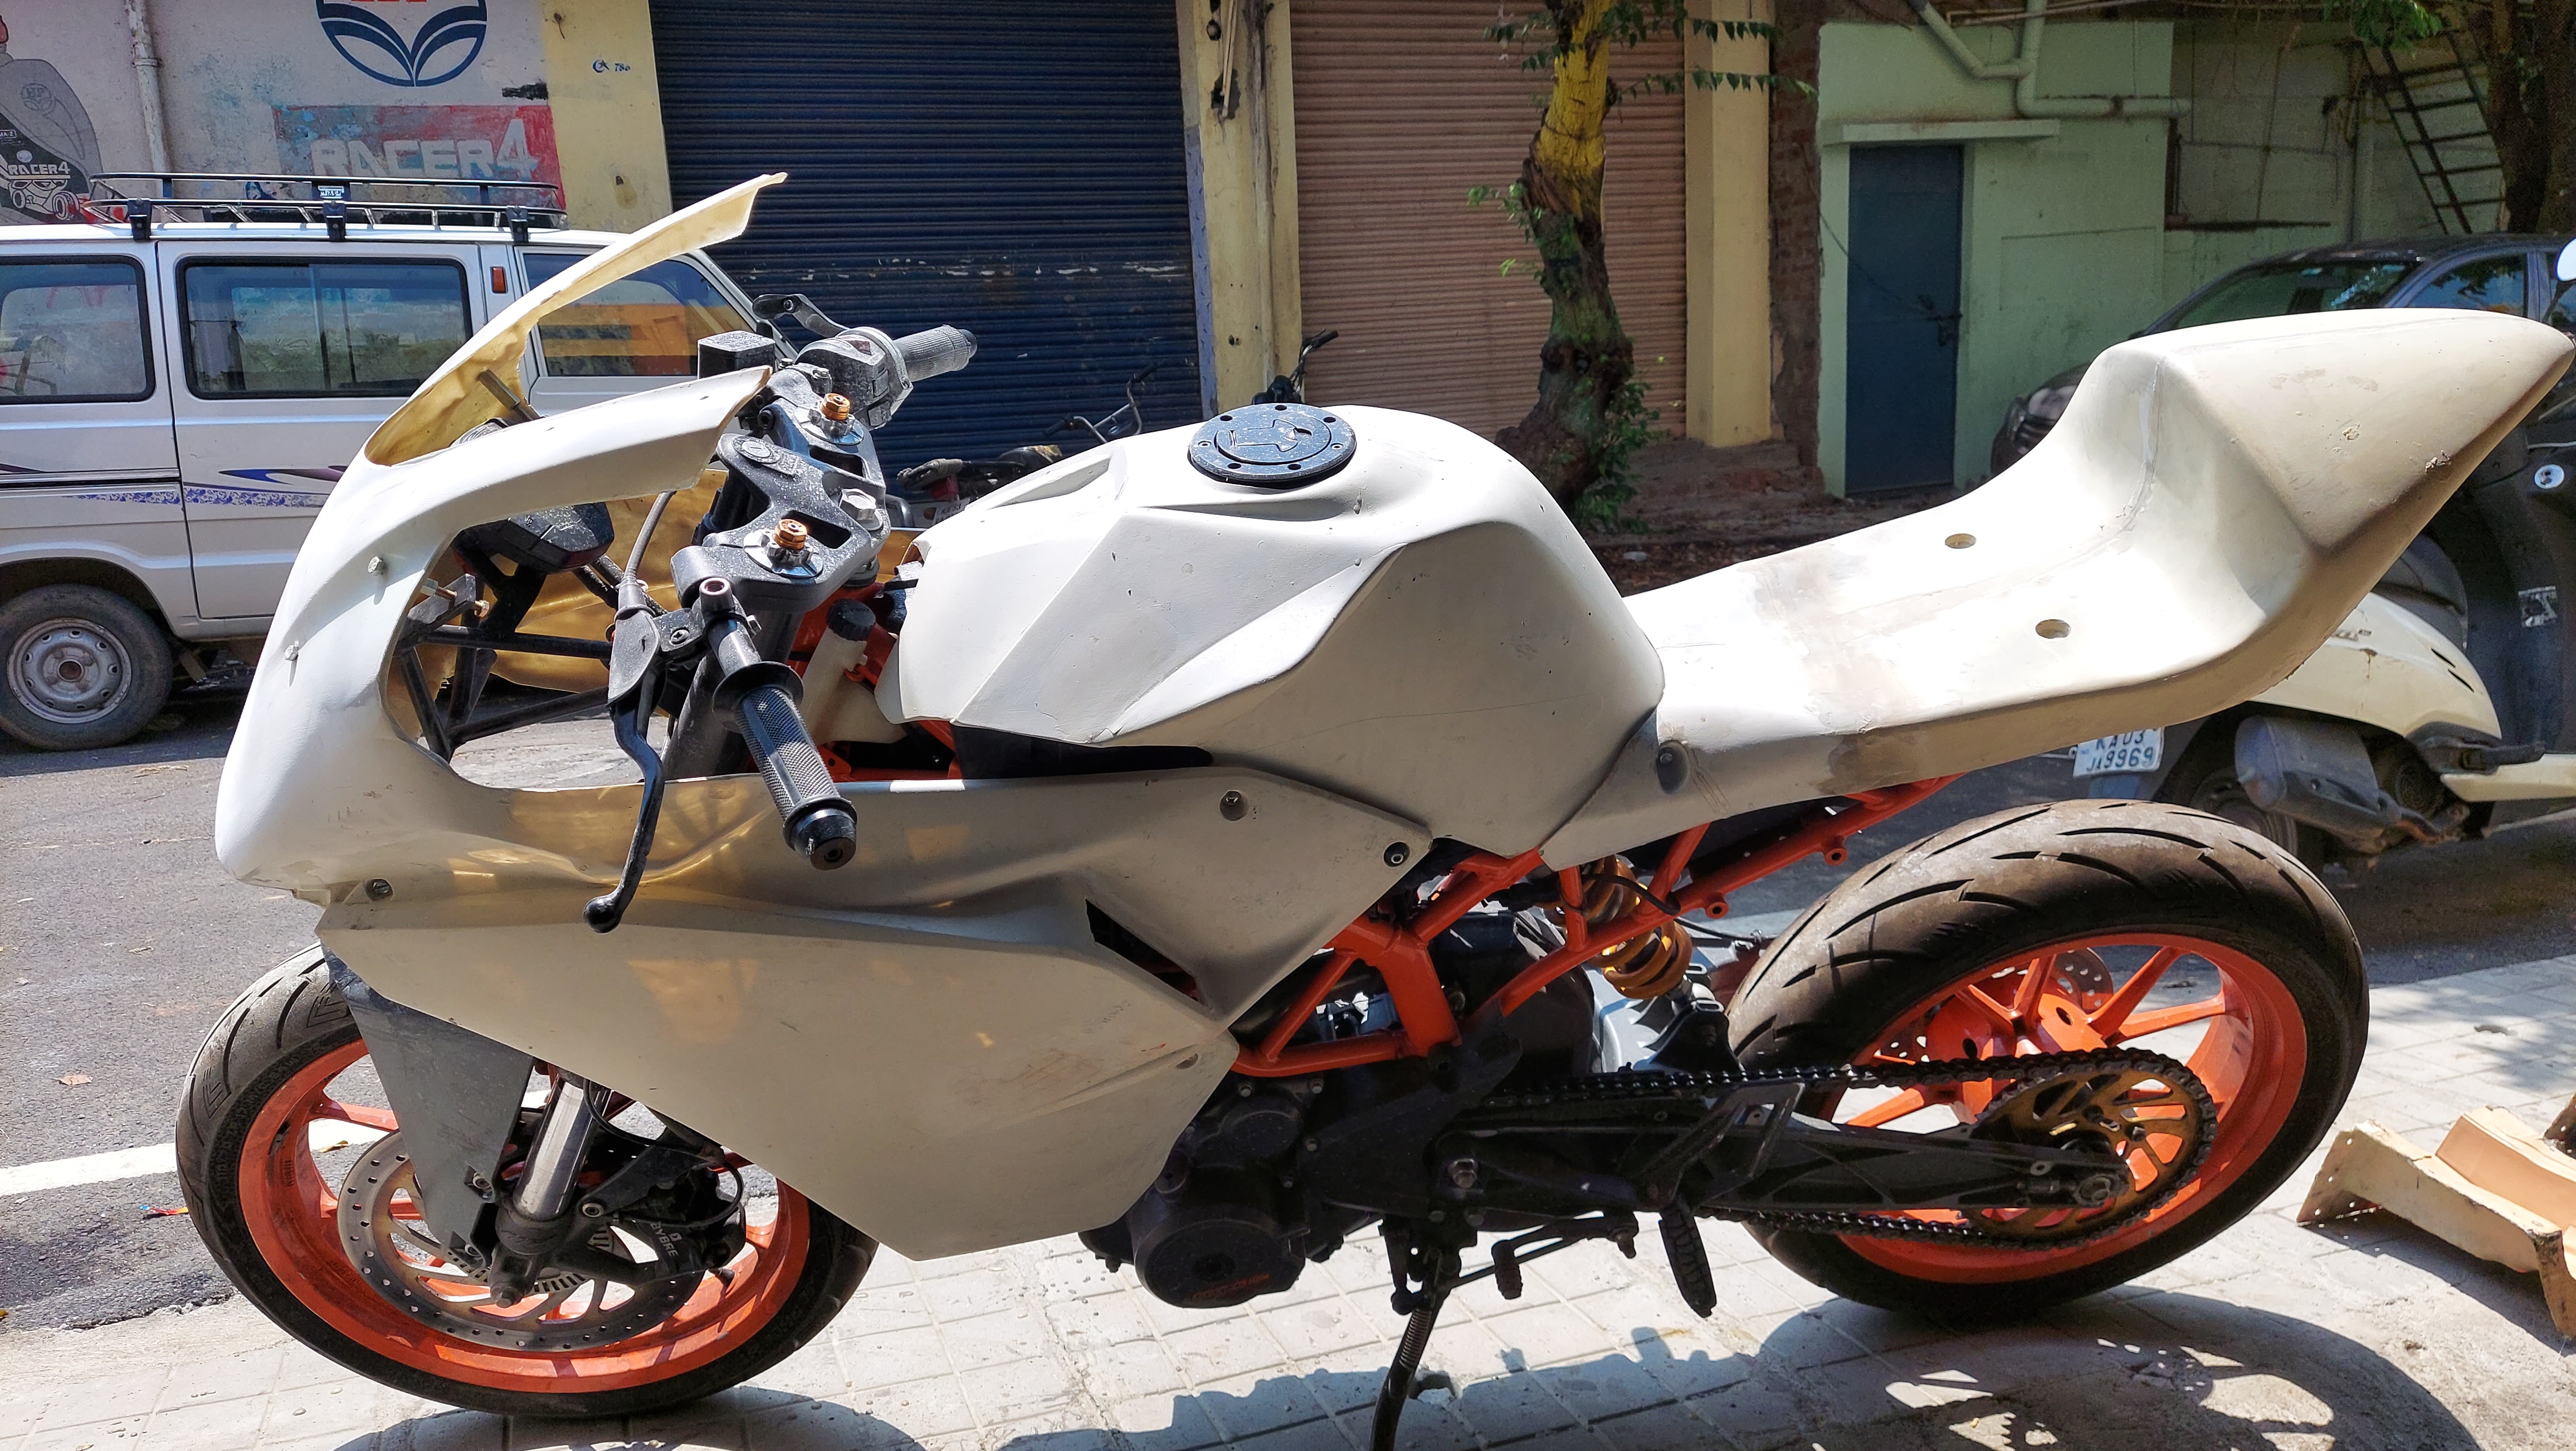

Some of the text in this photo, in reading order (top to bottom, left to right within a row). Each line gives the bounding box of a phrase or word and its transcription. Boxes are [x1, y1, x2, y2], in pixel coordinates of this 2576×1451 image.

[310, 119, 539, 179] RACER4
[8, 162, 71, 175] RACER4
[650, 1221, 679, 1257] BYBRE
